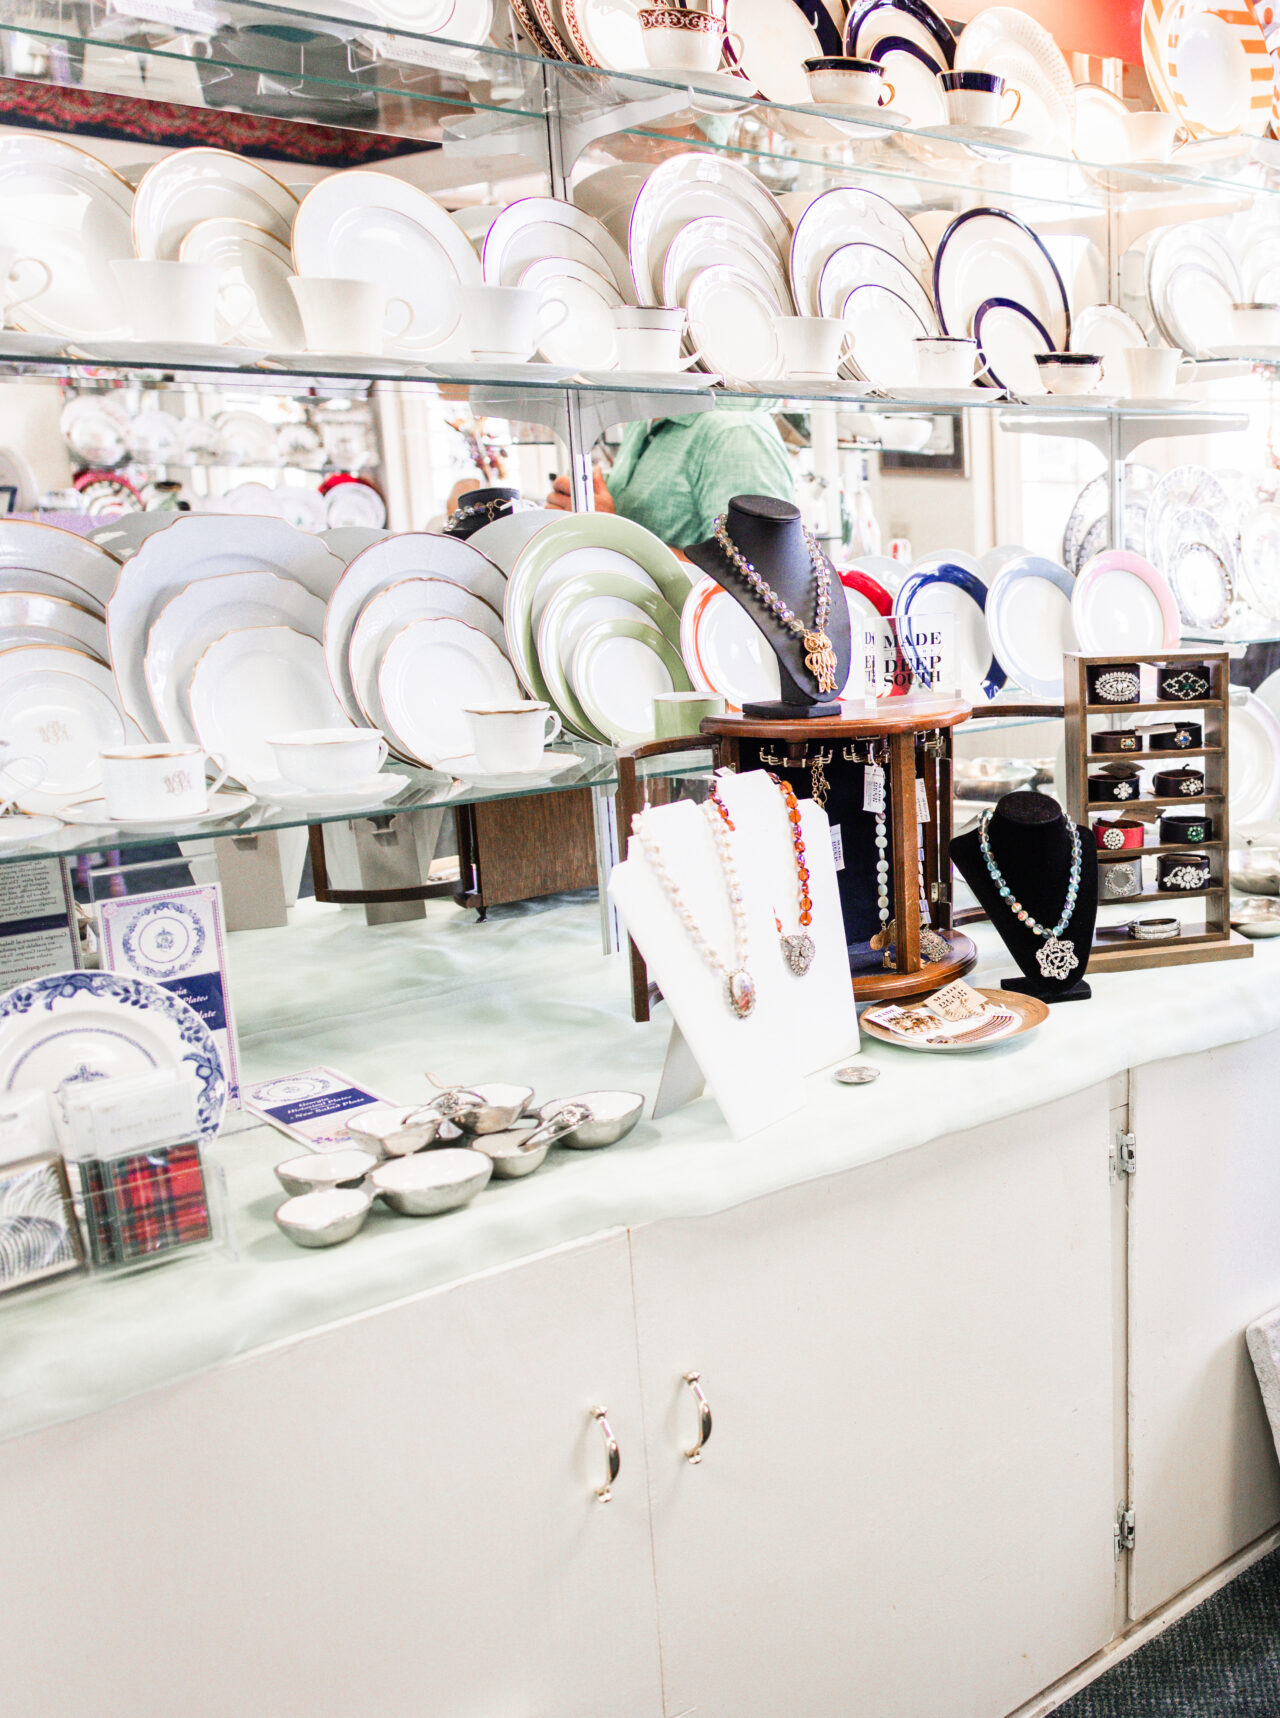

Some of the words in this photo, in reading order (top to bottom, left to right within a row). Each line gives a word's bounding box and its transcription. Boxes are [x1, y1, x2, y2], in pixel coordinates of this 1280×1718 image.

[883, 632, 942, 649] MADE
[884, 655, 942, 674] DEEP
[883, 671, 941, 687] SOUTH
